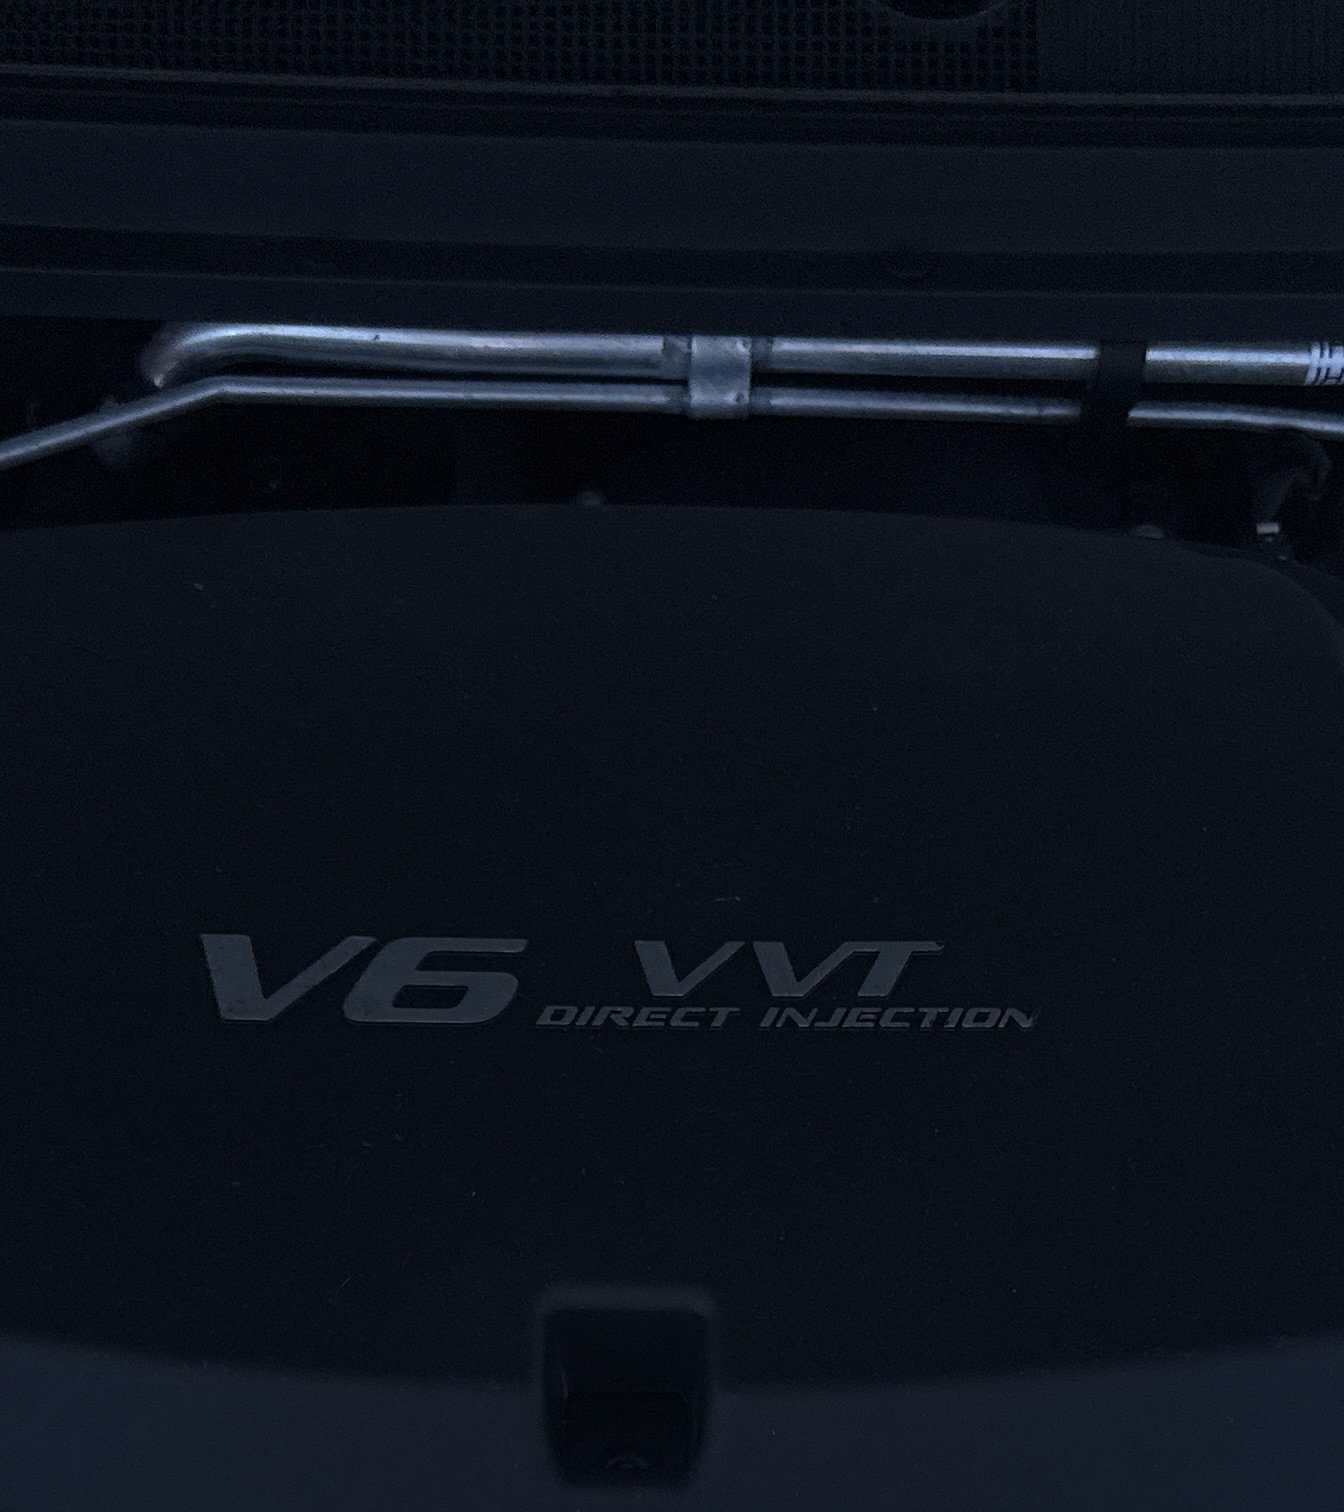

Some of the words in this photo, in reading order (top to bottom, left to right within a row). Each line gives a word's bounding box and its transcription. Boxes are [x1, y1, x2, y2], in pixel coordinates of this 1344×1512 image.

[200, 933, 529, 1024] V6
[634, 940, 945, 998] VVT
[535, 1005, 741, 1028] DIRECT
[759, 1007, 1036, 1029] INJECTION
